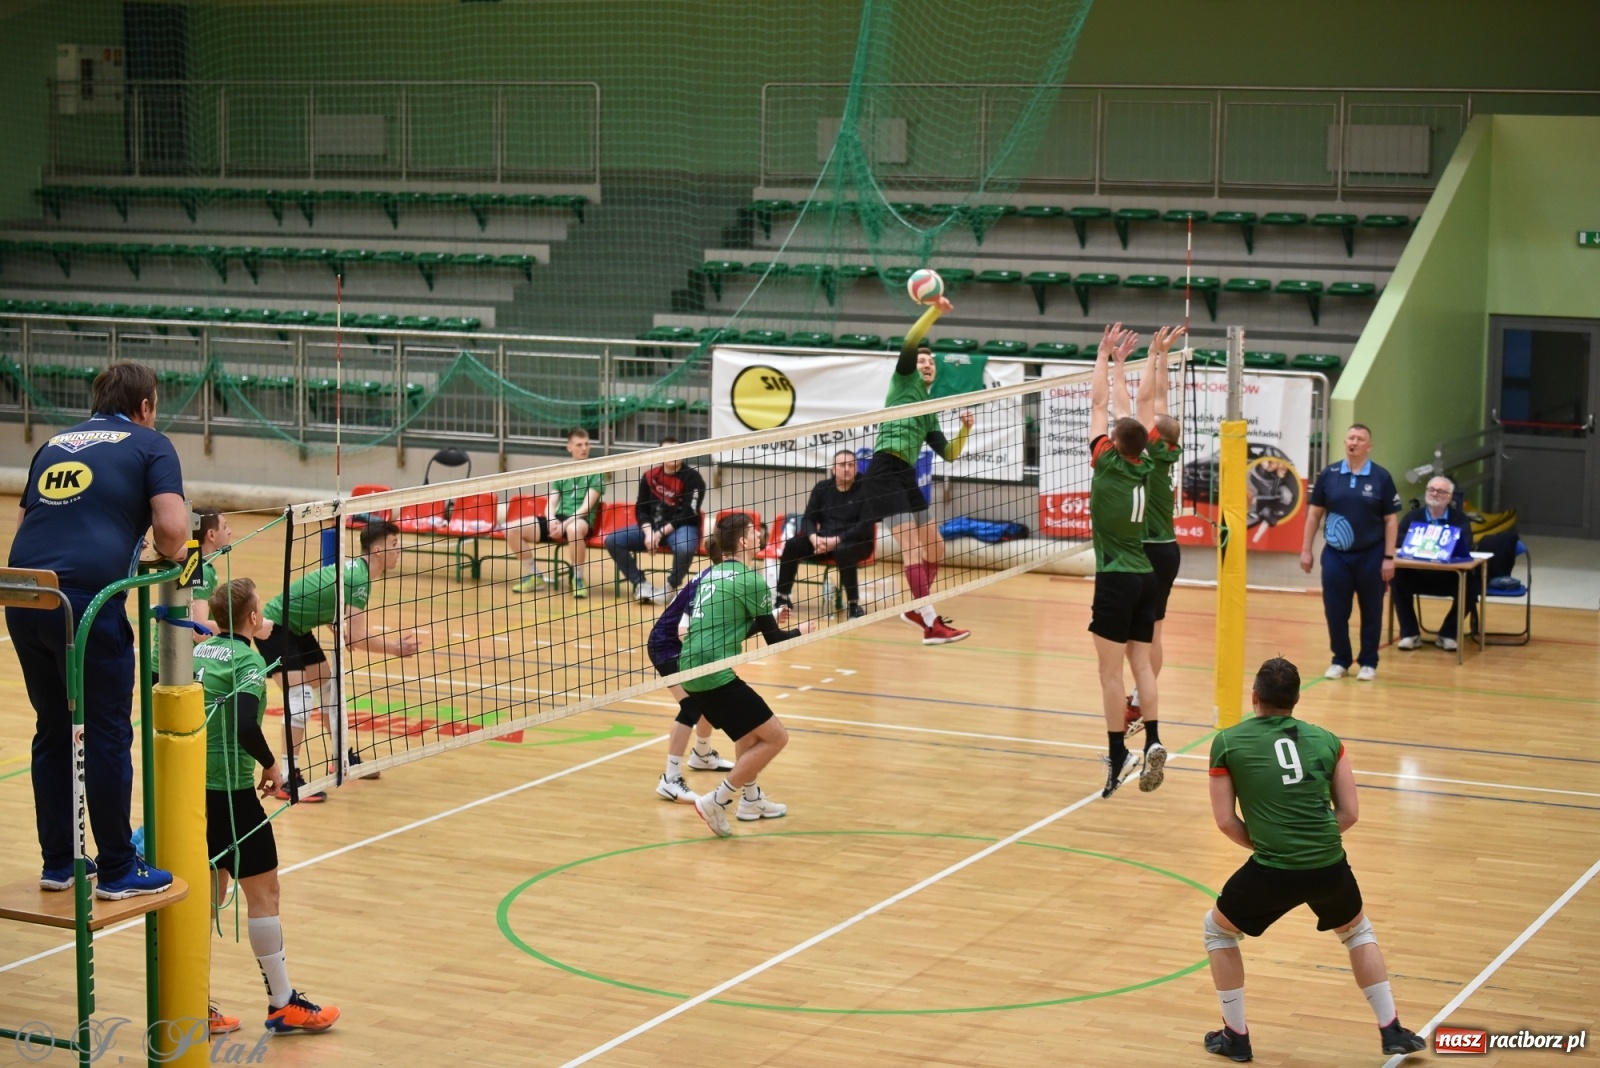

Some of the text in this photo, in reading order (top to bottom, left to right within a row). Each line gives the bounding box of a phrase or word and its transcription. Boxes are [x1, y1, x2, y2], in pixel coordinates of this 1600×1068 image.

[45, 470, 84, 490] HK
[1131, 485, 1145, 522] 11
[1274, 738, 1303, 785] 9
